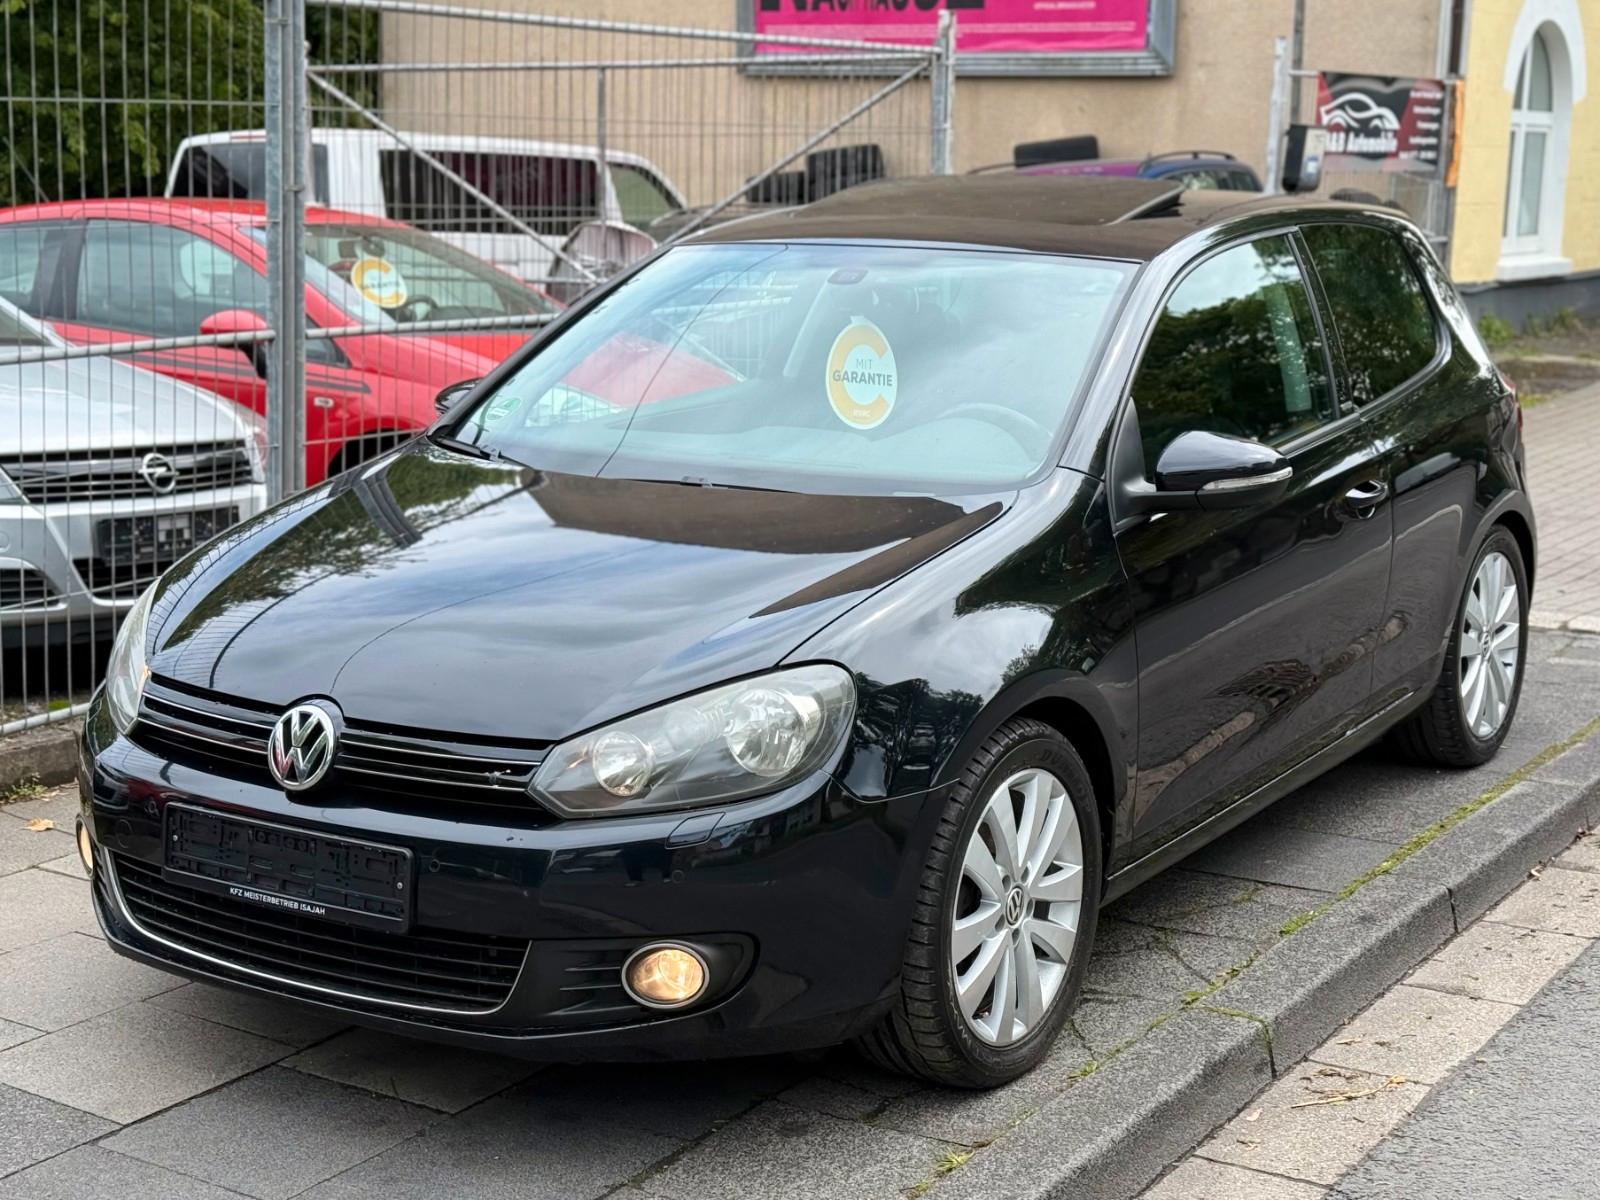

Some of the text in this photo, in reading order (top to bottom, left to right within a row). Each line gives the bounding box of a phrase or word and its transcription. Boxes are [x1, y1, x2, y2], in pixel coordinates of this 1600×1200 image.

[1347, 131, 1398, 152] Automobile
[856, 359, 873, 370] MIT
[832, 369, 893, 387] GARANTIE
[230, 887, 325, 915] KFZ MEISTERBETRIEB ISAJAH
